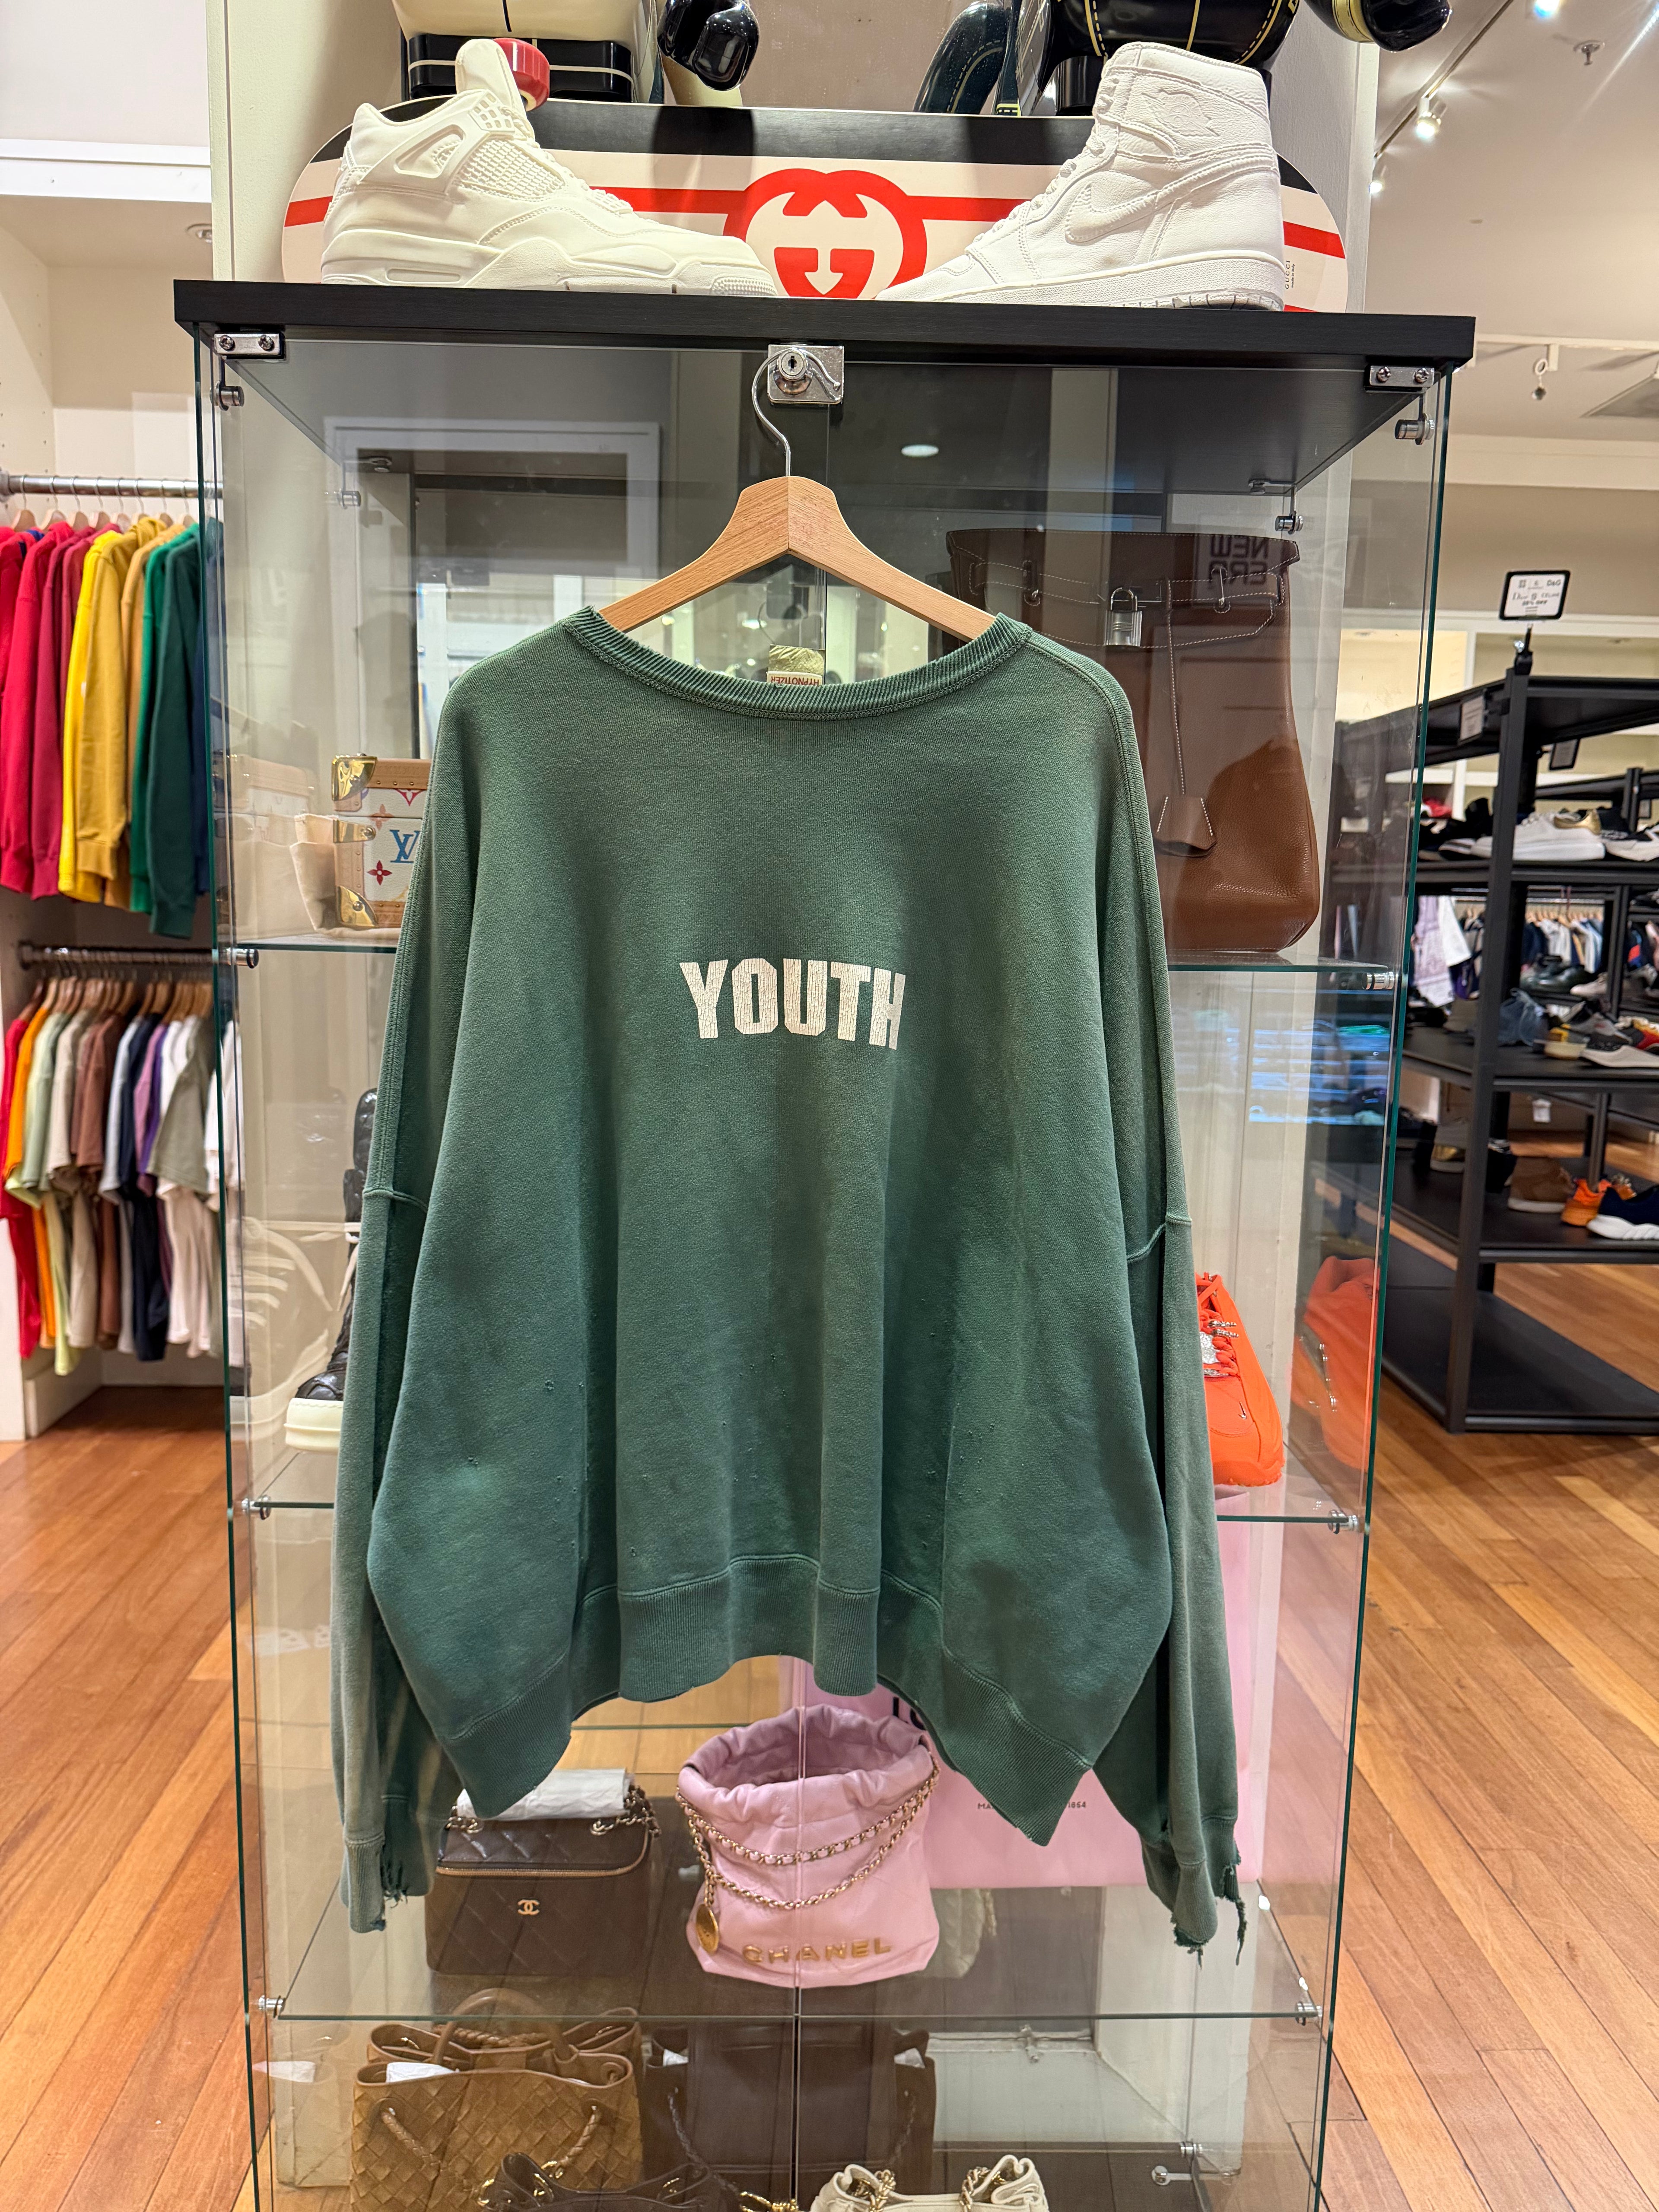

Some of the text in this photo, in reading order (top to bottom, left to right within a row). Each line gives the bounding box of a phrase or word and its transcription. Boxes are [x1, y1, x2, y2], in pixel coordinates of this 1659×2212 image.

[771, 676, 819, 686] HYPNOTIZER
[679, 958, 906, 1051] YOUTH
[742, 1938, 891, 1965] CHANEL
